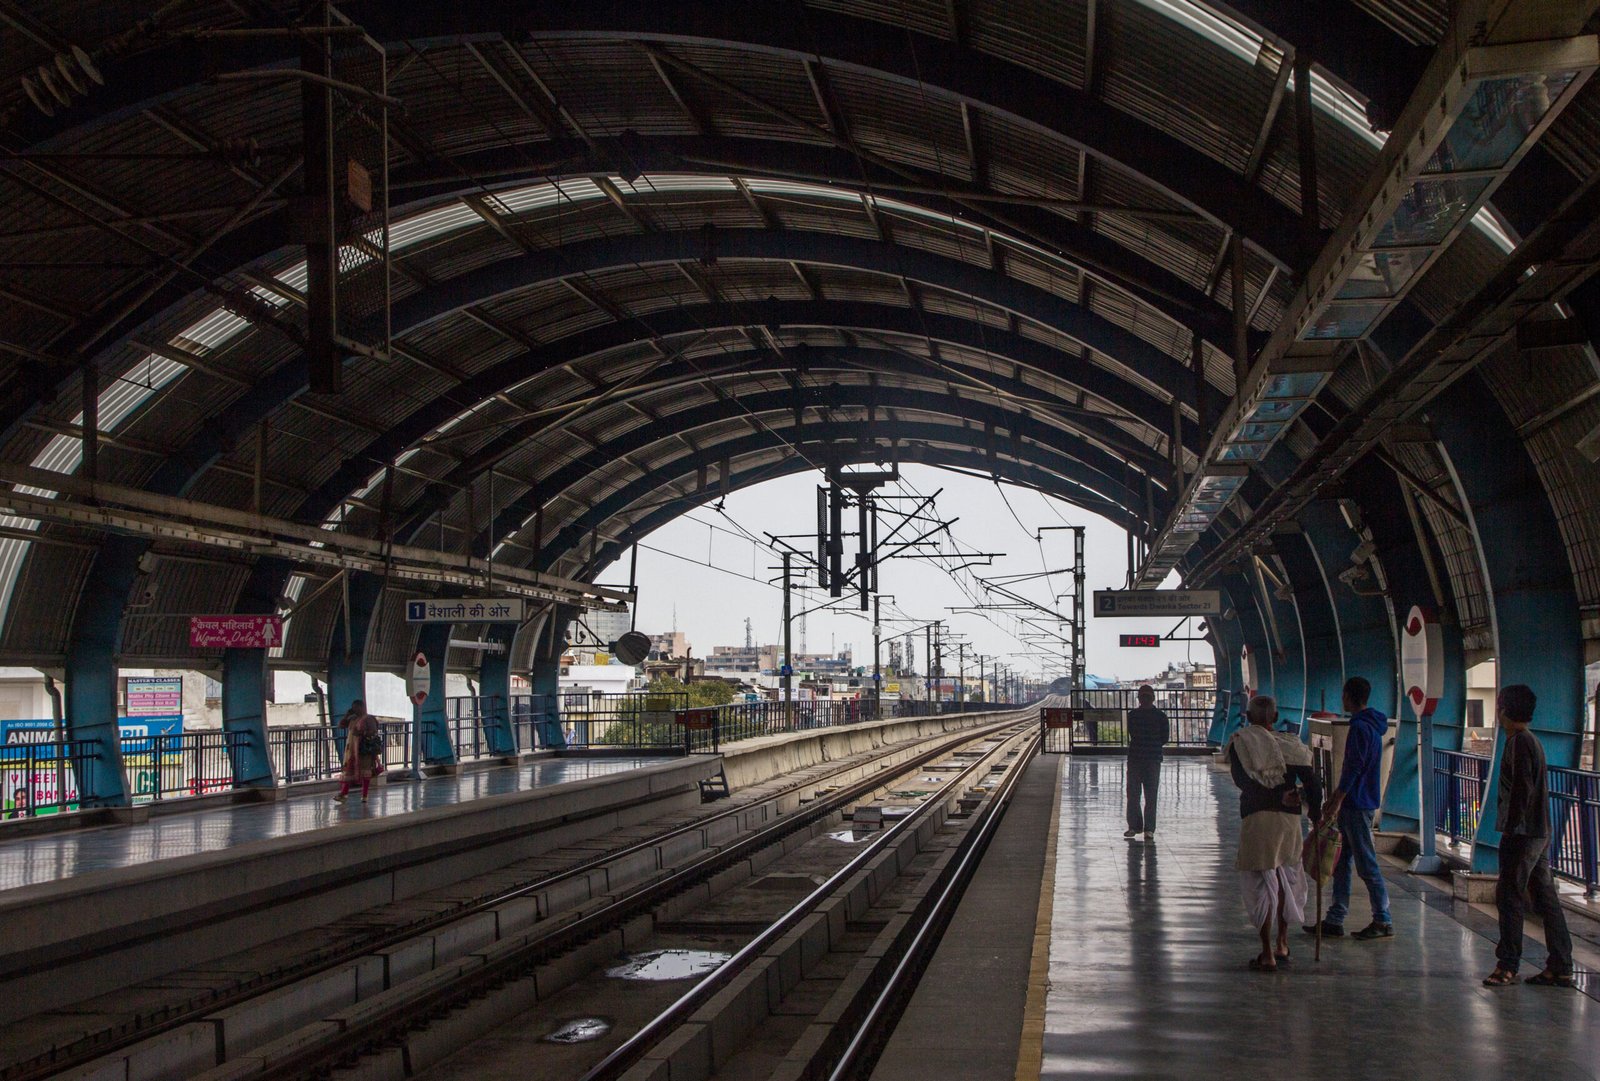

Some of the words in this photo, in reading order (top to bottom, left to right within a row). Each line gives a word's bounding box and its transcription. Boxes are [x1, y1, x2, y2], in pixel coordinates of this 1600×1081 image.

[428, 604, 466, 618] वैशाली
[469, 603, 485, 618] की
[488, 603, 511, 617] ओर
[197, 619, 220, 630] केवल
[195, 631, 227, 643] Women
[232, 631, 256, 646] Only
[1127, 636, 1155, 647] 11:43
[1193, 674, 1213, 685] HOTEL
